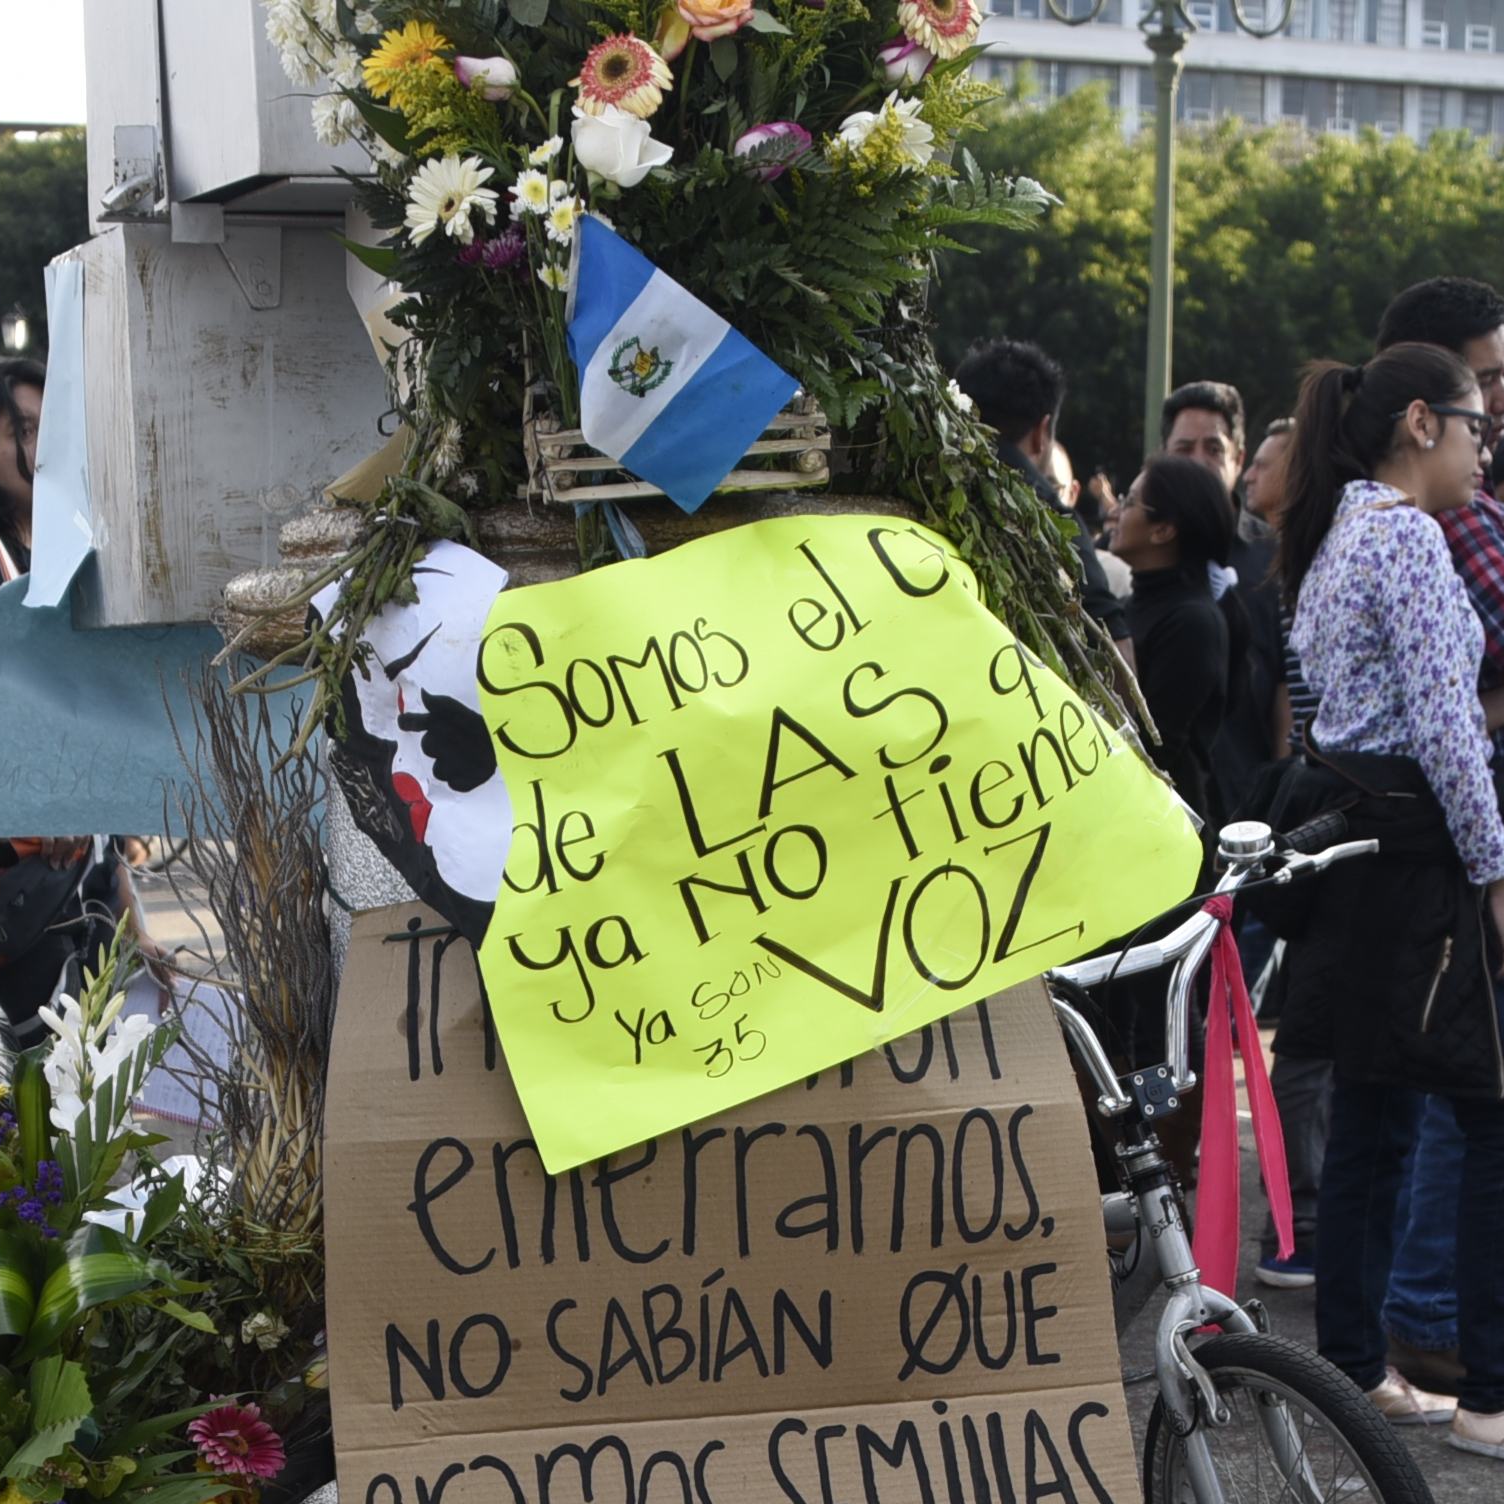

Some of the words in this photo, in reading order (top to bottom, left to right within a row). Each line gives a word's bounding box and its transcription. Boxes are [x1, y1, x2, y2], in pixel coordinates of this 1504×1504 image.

[477, 616, 750, 759] Somos
[788, 538, 873, 652] el
[501, 778, 608, 896] de
[657, 660, 949, 859] LAS
[988, 643, 1049, 722] q
[508, 915, 650, 1024] ya
[672, 822, 829, 948] NO
[614, 1007, 679, 1065] Ya
[691, 955, 784, 1020] SON
[751, 822, 1086, 1013] VOZ
[691, 1014, 768, 1078] 35
[384, 1312, 513, 1411] NO
[545, 1267, 834, 1403] SABÍAN
